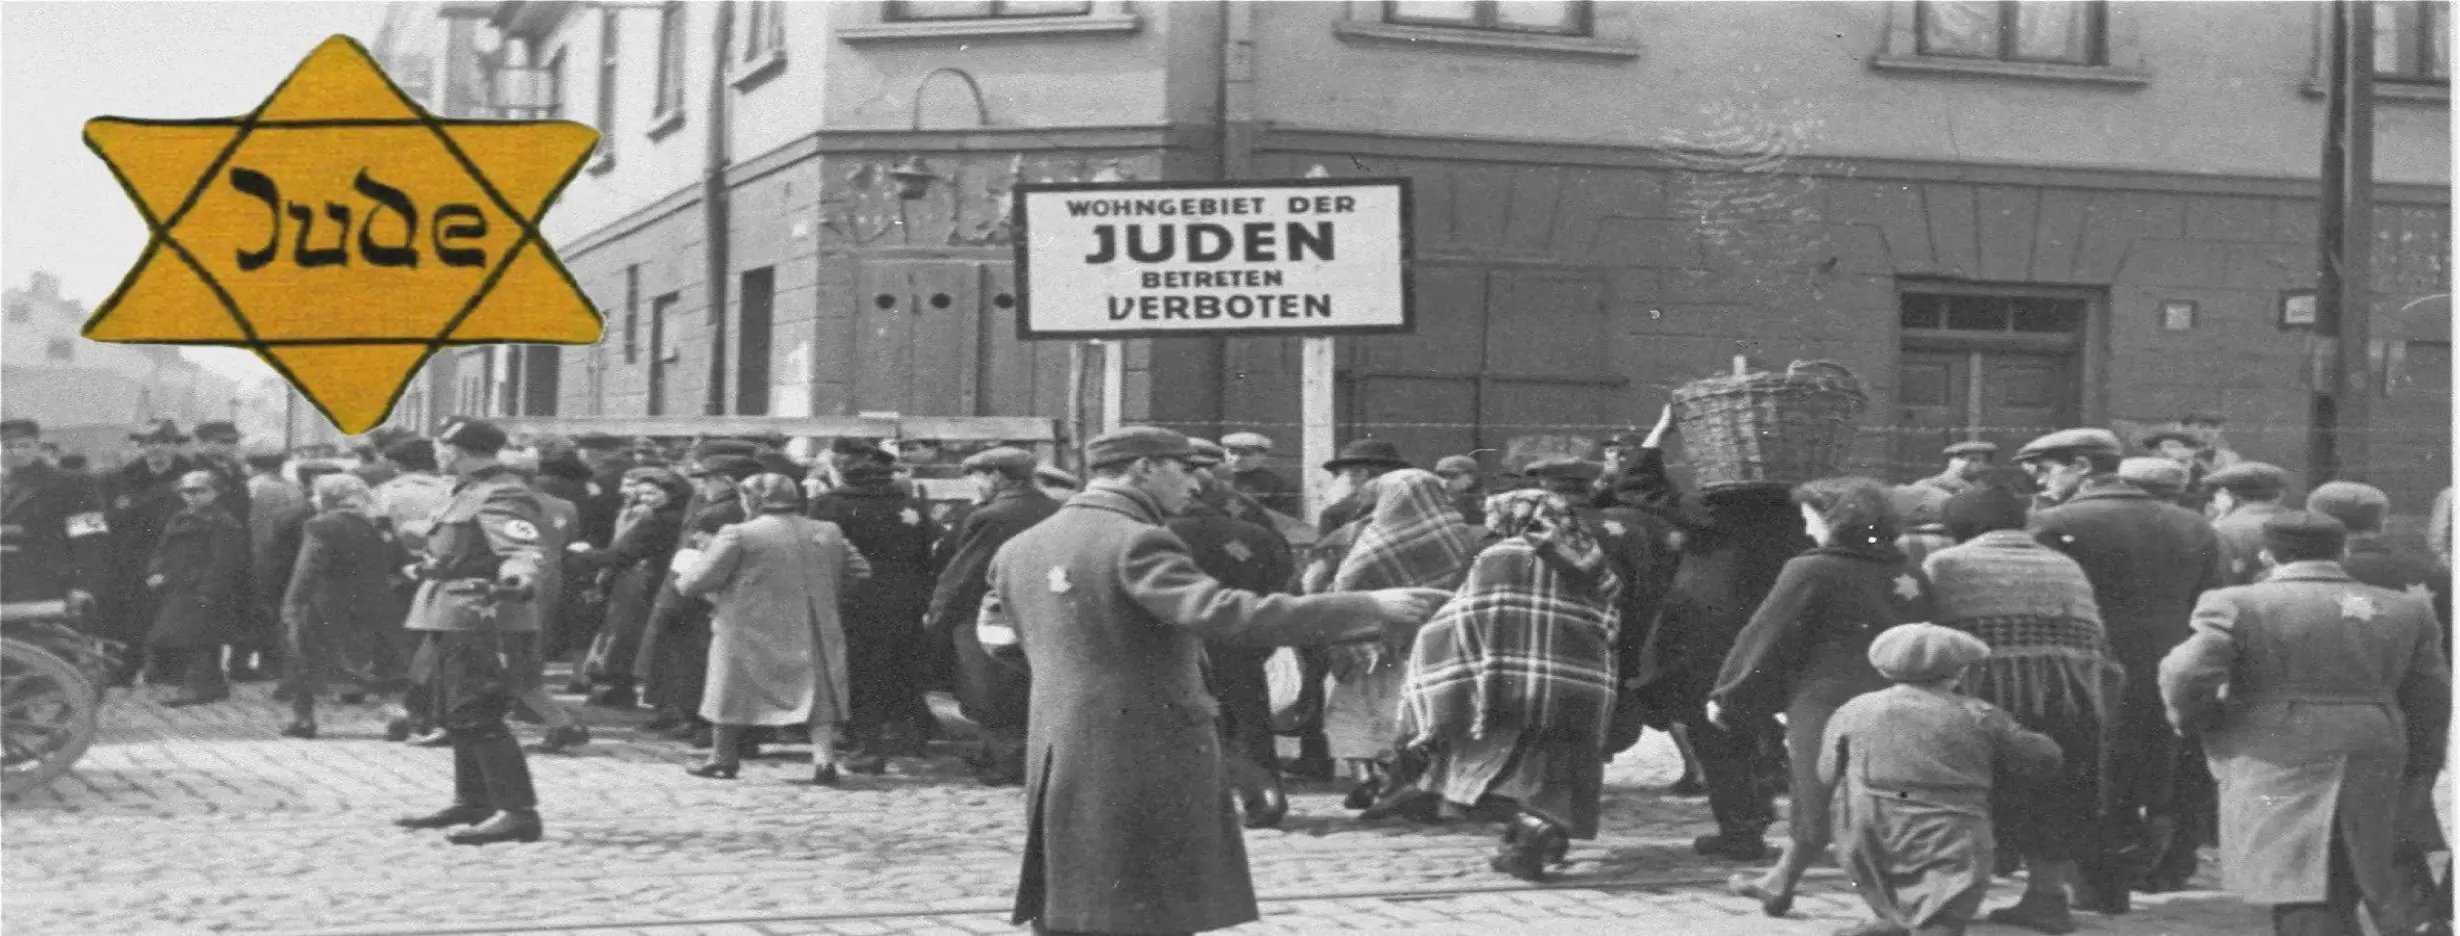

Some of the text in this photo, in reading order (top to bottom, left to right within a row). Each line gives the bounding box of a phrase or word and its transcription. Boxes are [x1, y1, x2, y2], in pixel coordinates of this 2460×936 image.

[1066, 195, 1356, 218] WOHNGEBIET DER
[1084, 221, 1336, 265] JUDEN
[1141, 269, 1284, 290] BETRETEN
[1108, 293, 1332, 321] VERBOTEN
